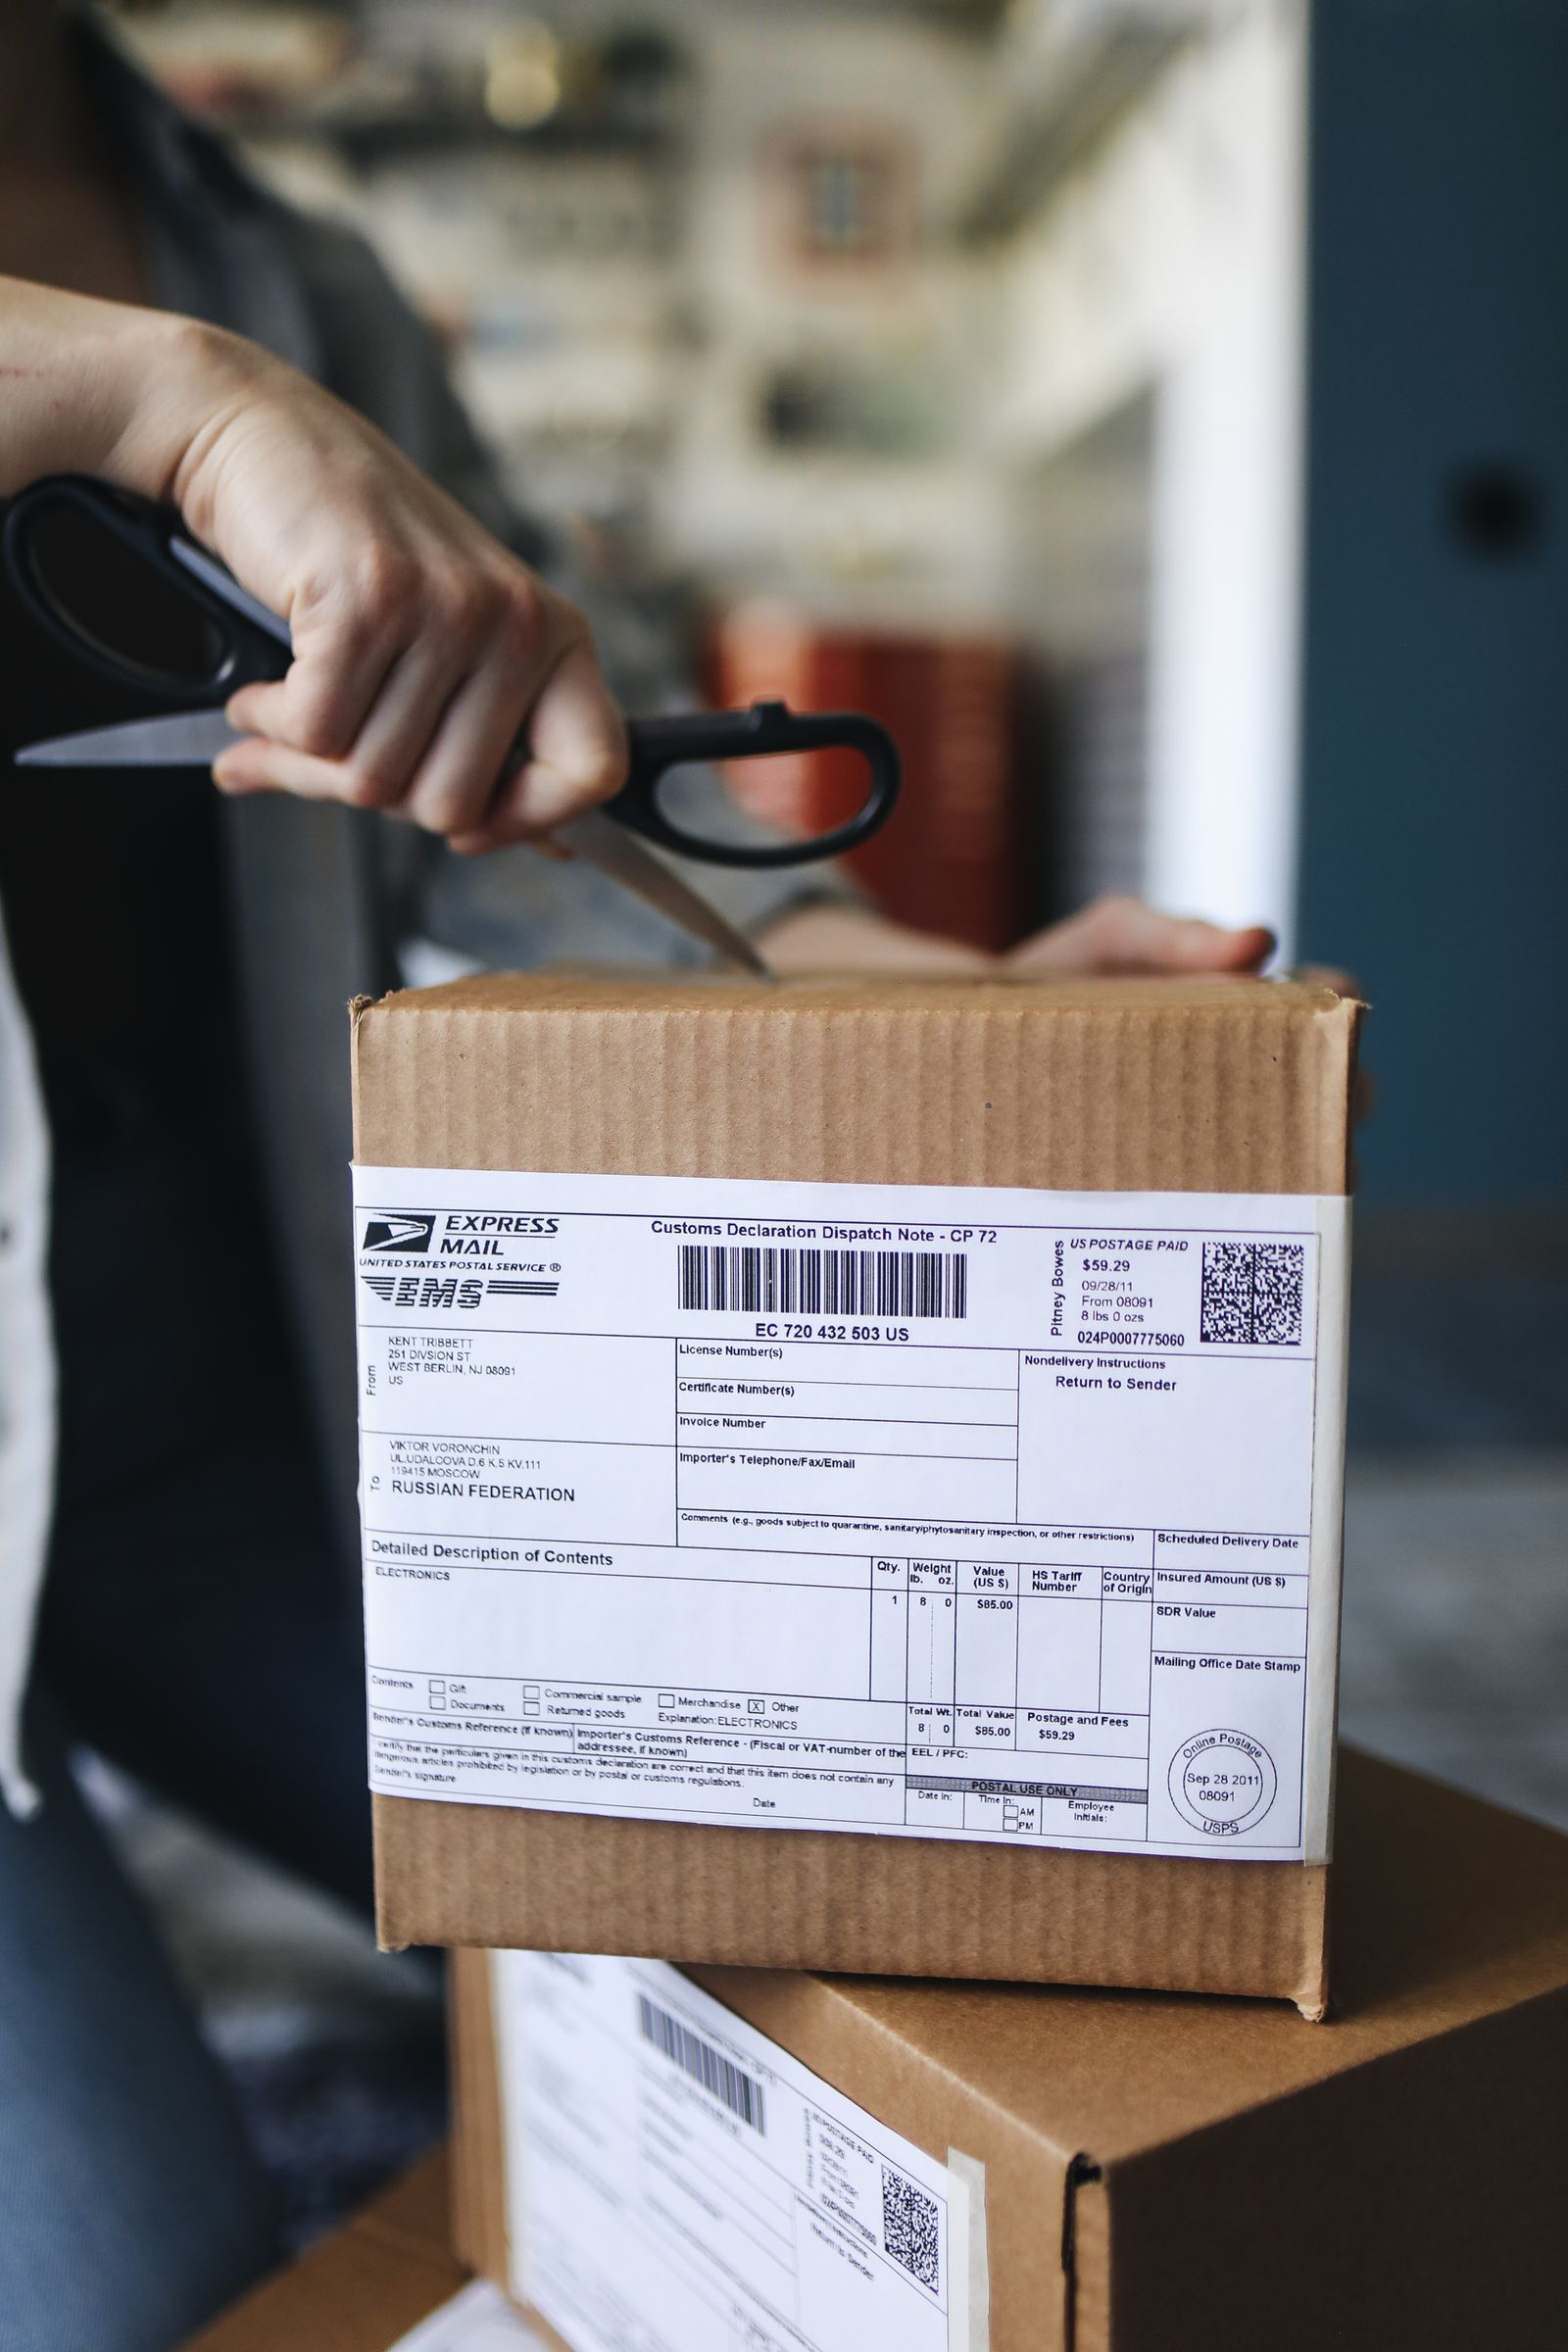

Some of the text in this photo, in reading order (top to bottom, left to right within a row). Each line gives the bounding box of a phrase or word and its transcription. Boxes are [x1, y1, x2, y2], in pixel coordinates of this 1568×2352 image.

[446, 1215, 560, 1233] EXPRESS
[652, 1220, 997, 1243] Customs Declaration Dispatch Note CP 72
[440, 1239, 504, 1255] MAIL
[1070, 1239, 1189, 1251] US POSTAGE PAID
[360, 1258, 546, 1272] UNITED STATES POSTAL SERVICE
[1083, 1258, 1130, 1272] $59.29
[394, 1277, 484, 1309] EMS
[1051, 1241, 1066, 1336] Pitney Bowes
[1081, 1280, 1132, 1292] 09/28/11
[1082, 1295, 1152, 1308] From 08091
[1081, 1310, 1089, 1321] 8
[1093, 1310, 1109, 1321] lbs
[756, 1323, 909, 1342] EC 720 432 503 US
[1077, 1331, 1185, 1347] 024P0007775060
[388, 1336, 473, 1348] KENT TRIBBETT
[388, 1348, 470, 1361] 251 DIVSION ST
[679, 1344, 783, 1359] License Number(s)
[388, 1361, 514, 1376] WEST BERLIN, NJ 08091
[1025, 1355, 1166, 1370] Nondelivery Instructions
[366, 1365, 376, 1396] From
[388, 1375, 404, 1386] US
[1055, 1376, 1177, 1391] Return to Sender
[679, 1382, 795, 1397] Certificate Number(s)
[680, 1416, 766, 1429] Invoice Number
[389, 1441, 500, 1455] VIKTOR VORONCHIN
[467, 1457, 540, 1469] D.6 K.5 KV.111
[680, 1452, 855, 1469] Importer's Telephone/Fax/Email
[391, 1466, 480, 1479] 119415 MOSCOW
[370, 1476, 380, 1492] To
[392, 1480, 574, 1501] RUSSIAN FEDERATION
[681, 1513, 728, 1523] Comments
[756, 1518, 783, 1527] goods
[786, 1519, 818, 1529] subject
[831, 1522, 882, 1531] quarantine,
[987, 1529, 1037, 1539] inspection,
[1078, 1532, 1135, 1542] restrictions)
[1157, 1534, 1298, 1549] Scheduled Delivery Date
[372, 1540, 612, 1566] Detailed Description of Contents
[375, 1567, 451, 1581] ELECTRONICS
[877, 1560, 900, 1574] Qty.
[912, 1562, 952, 1575] Weight
[973, 1566, 1004, 1577] Value
[1032, 1570, 1083, 1582] HS Tariff
[1103, 1571, 1150, 1586] Country
[1157, 1572, 1272, 1588] Insured Amount (US
[973, 1578, 994, 1590] (US
[1032, 1581, 1077, 1592] Number
[1103, 1583, 1152, 1596] of Origin
[977, 1598, 1013, 1610] $85.00
[1156, 1606, 1216, 1618] SDR Value
[1154, 1656, 1300, 1674] Mailing Office Date Stamp
[449, 1684, 466, 1693] Gift
[545, 1689, 642, 1704] Commercial sample
[678, 1696, 741, 1709] Merchandise
[451, 1699, 505, 1712] Documents
[547, 1705, 625, 1719] Returned goods
[771, 1701, 799, 1713] Other
[908, 1706, 933, 1715] Total
[956, 1708, 1014, 1720] Total Value
[1027, 1712, 1129, 1727] Postage and Fees
[466, 1722, 573, 1739] Reference known)
[975, 1726, 1010, 1737] $85.00
[1039, 1729, 1075, 1740] $59.29
[577, 1729, 632, 1740] Importer's
[634, 1732, 683, 1743] Customs
[685, 1736, 740, 1747] Reference
[750, 1740, 785, 1750] (Fiscal
[875, 1747, 886, 1757] of
[577, 1741, 687, 1758] addressee, known)
[1183, 1733, 1262, 1759] Online Postage
[911, 1747, 968, 1759] EEL PFC:
[596, 1756, 874, 1784] declaration contain
[1187, 1773, 1258, 1787] Sep 28 2011
[918, 1790, 938, 1799] Date
[971, 1781, 1078, 1797] POSTAL USE ONLY
[1199, 1789, 1234, 1802] 08091
[753, 1797, 776, 1808] Date
[978, 1794, 1001, 1803] Time
[1019, 1807, 1035, 1816] AM
[1068, 1800, 1114, 1812] Employee
[1202, 1820, 1240, 1835] USPS
